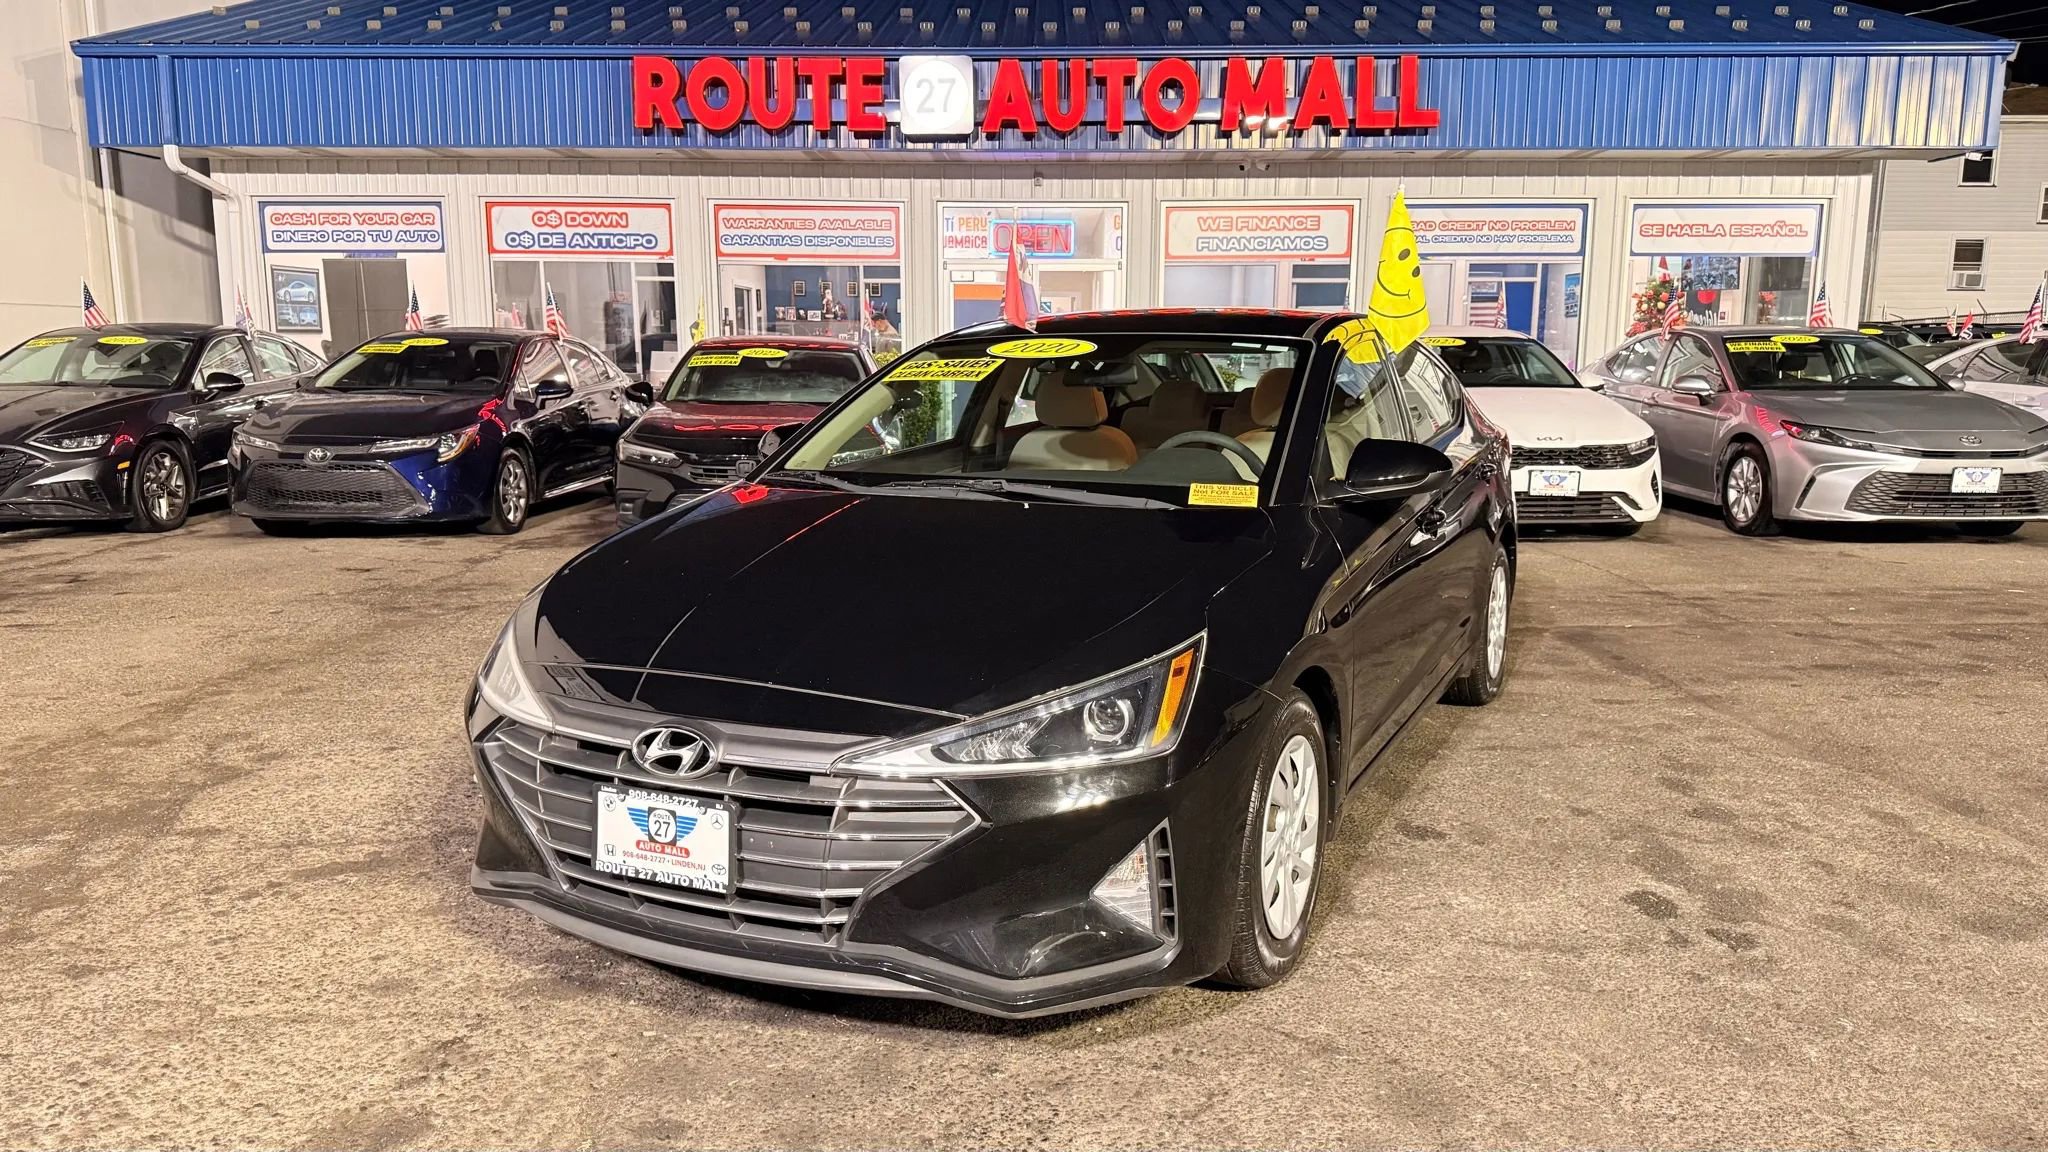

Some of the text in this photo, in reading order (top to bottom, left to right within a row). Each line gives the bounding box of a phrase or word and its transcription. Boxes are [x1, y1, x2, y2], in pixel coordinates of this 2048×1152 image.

[633, 54, 1440, 134] ROUTE 27 AUTO MALL
[270, 212, 435, 226] CASH FOR YOUR CAR
[564, 211, 629, 228] DOWN
[722, 217, 892, 231] WARRANTIES AVAILABLE
[1197, 215, 1320, 231] WE FINANCE
[1438, 220, 1486, 232] CREDIT
[1488, 220, 1509, 232] NO
[1511, 220, 1576, 232] PROBLEM
[271, 229, 440, 243] DINERO POR TU AUTO
[1639, 220, 1808, 237] SE HABLA ESPAÑOL
[538, 232, 566, 249] DE
[568, 232, 658, 249] ANTICIPO
[720, 234, 894, 248] GARANTIAS DISPONIBLES
[993, 222, 1072, 254] OPEN
[1196, 235, 1328, 252] FINANCIAMOS
[1431, 234, 1475, 244] CREDITO
[1476, 234, 1492, 244] NO
[1493, 234, 1516, 244] HAY
[1518, 234, 1574, 244] PROBLEMA
[1007, 343, 1081, 353] 2020
[889, 370, 987, 379] CLEAN CARFAX
[601, 785, 617, 793] Linden
[628, 789, 699, 808] 908-648-2727
[653, 812, 671, 821] ROUTE
[653, 819, 671, 839] 27
[622, 850, 666, 864] 908-648-2727
[638, 841, 689, 858] AUTO MALL
[595, 859, 727, 894] ROUTE 27 AUTO MALL
